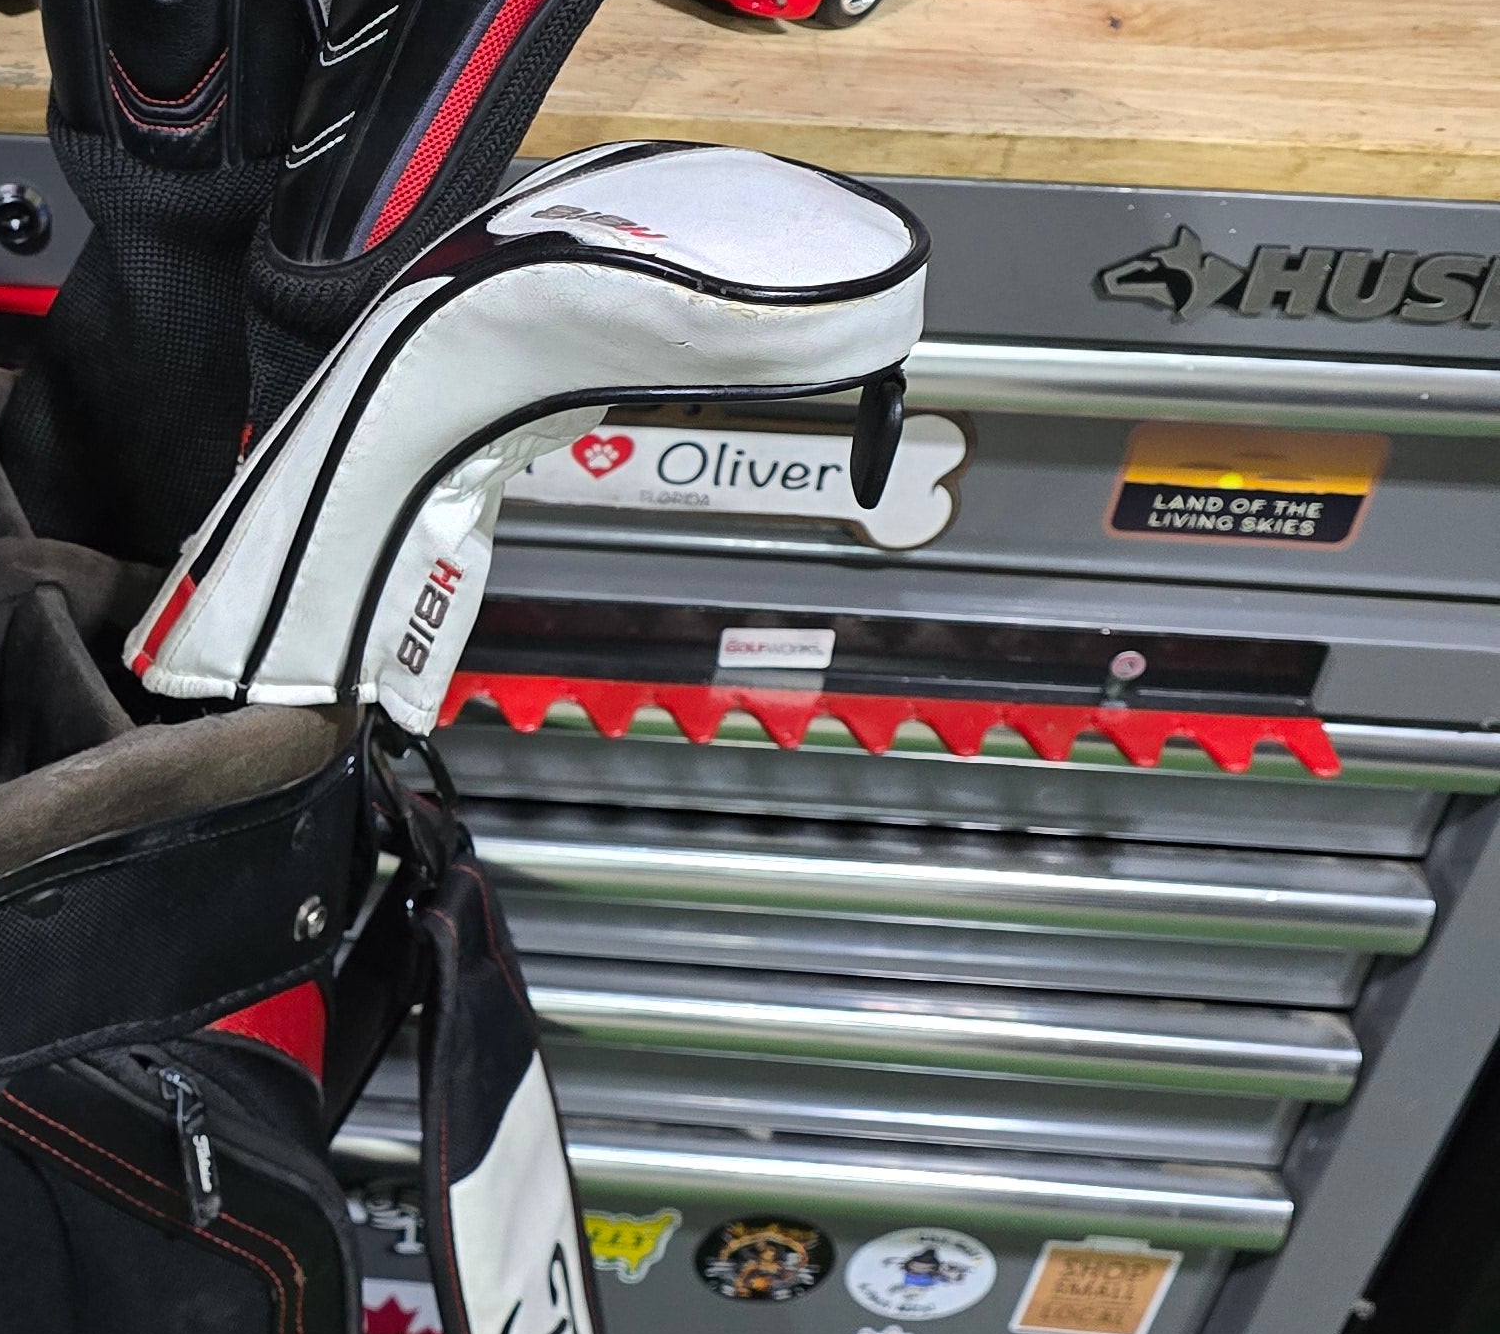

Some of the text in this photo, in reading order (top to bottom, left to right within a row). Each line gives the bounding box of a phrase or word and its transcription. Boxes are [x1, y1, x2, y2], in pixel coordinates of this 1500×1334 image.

[657, 440, 843, 493] Oliver
[639, 489, 712, 507] FLORIDA
[1151, 493, 1325, 519] LAND OF THE
[1147, 511, 1316, 537] LIVING SKIES
[396, 557, 464, 676] 818H
